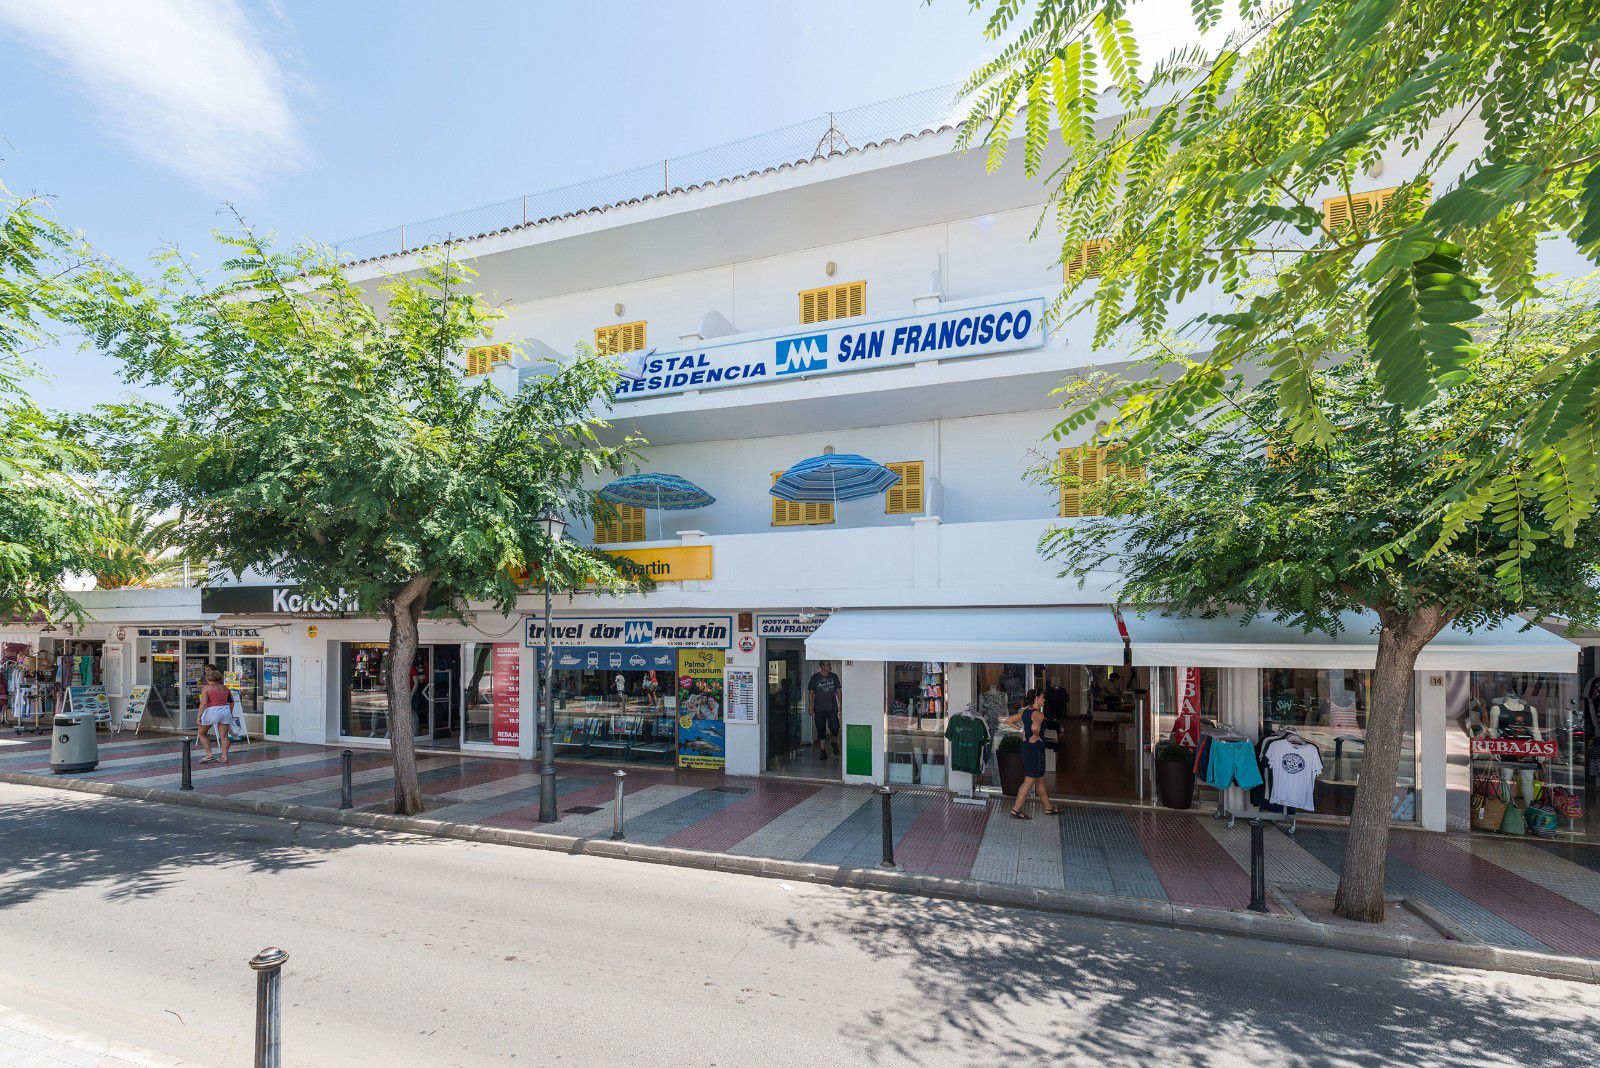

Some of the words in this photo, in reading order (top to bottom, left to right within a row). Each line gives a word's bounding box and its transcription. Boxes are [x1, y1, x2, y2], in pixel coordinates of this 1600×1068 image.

[838, 331, 884, 364] SAN
[891, 309, 1033, 356] FRANCISCO
[643, 354, 711, 374] STAL
[615, 362, 767, 394] RESIDENCIA
[654, 622, 727, 639] martin
[763, 625, 782, 633] SAN
[684, 661, 706, 669] Palma
[1433, 677, 1442, 686] 14
[1472, 740, 1554, 754] REBAJAS
